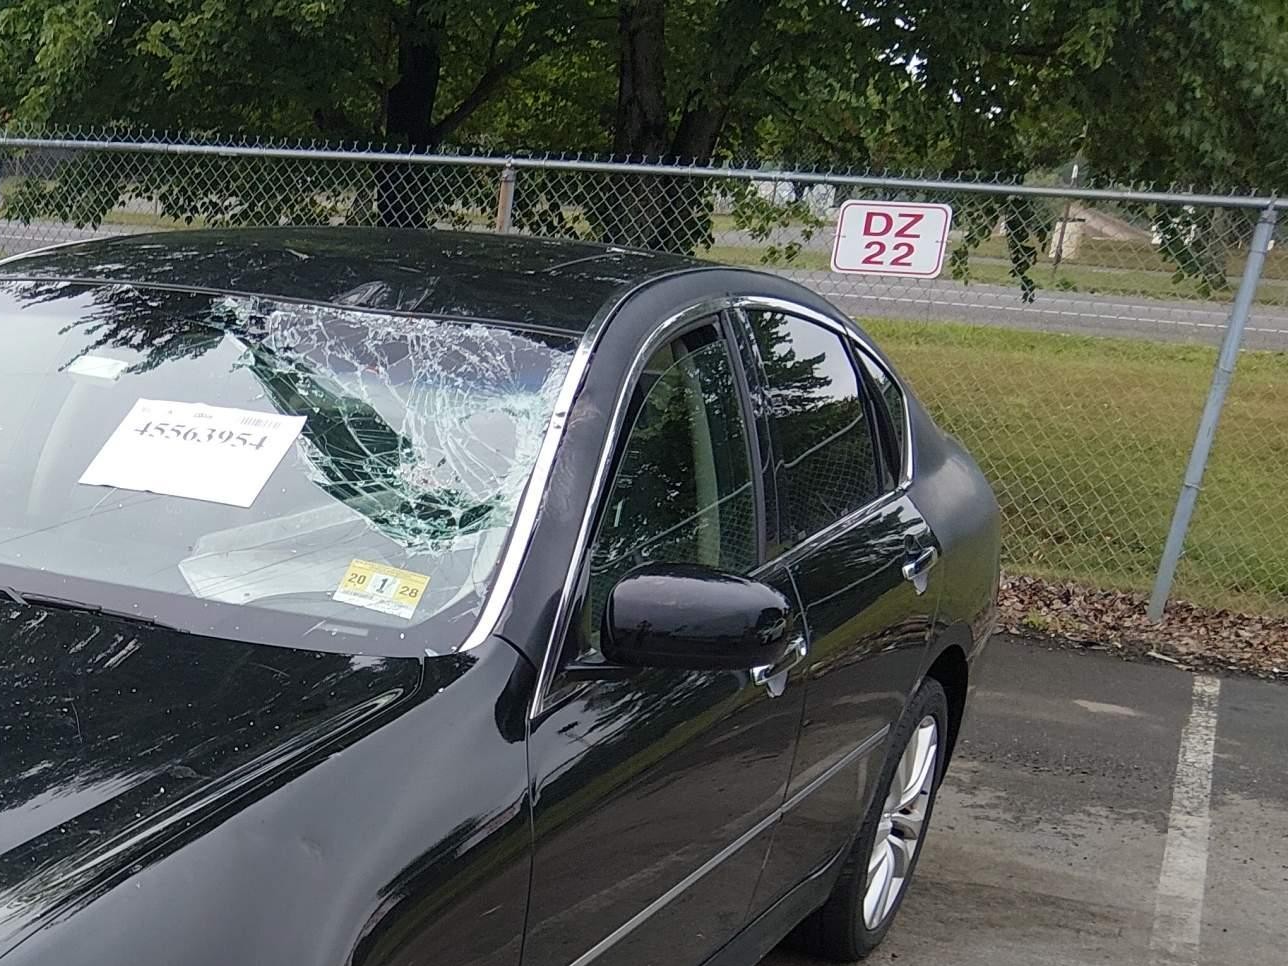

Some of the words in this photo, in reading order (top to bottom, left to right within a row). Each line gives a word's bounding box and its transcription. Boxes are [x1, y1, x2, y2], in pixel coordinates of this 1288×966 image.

[862, 212, 924, 238] DZ
[861, 241, 915, 266] 22
[134, 420, 268, 450] 45563954
[348, 572, 366, 585] 20
[376, 577, 388, 593] 1
[399, 586, 419, 598] 28
